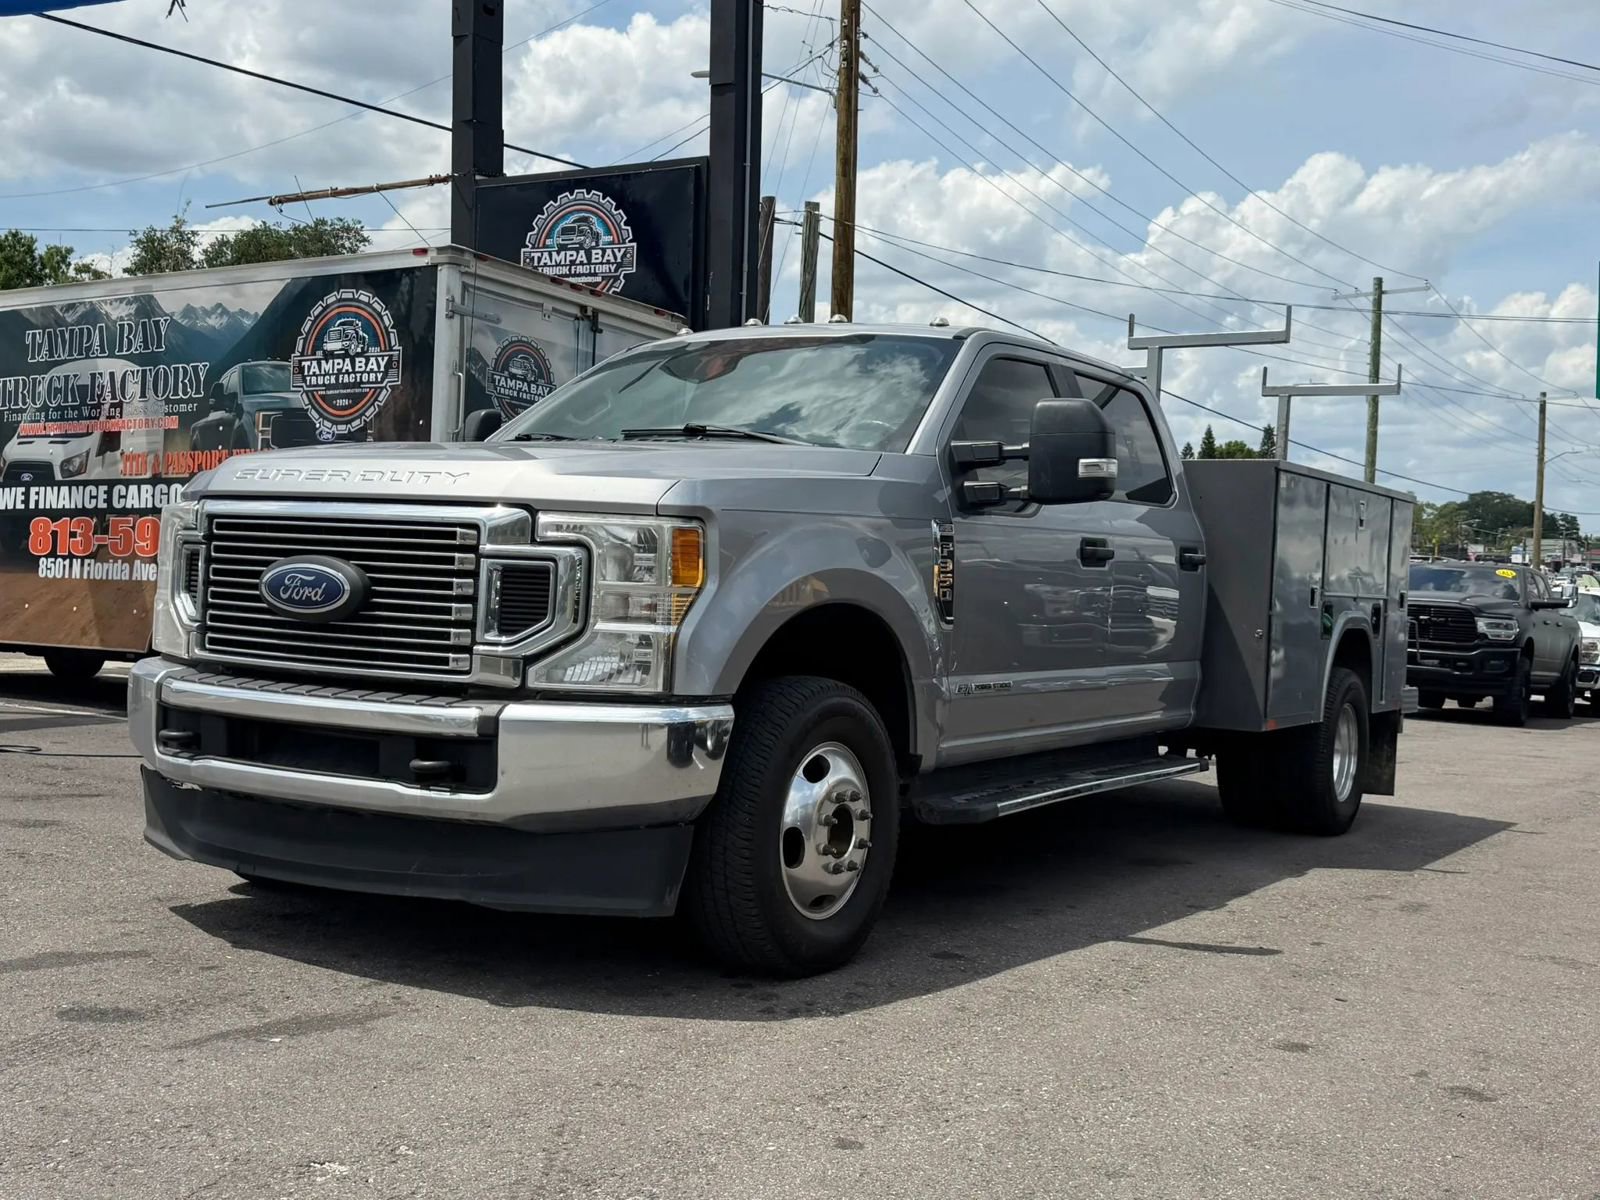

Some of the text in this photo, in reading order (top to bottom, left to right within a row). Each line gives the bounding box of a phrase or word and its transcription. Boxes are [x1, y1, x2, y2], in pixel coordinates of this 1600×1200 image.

[531, 248, 626, 266] TAMPA BAY
[538, 264, 617, 276] TRUCK FACTORY
[26, 317, 170, 362] TAMPA BAY
[302, 356, 389, 375] TAMPA BAY
[0, 362, 209, 409] TRUCK FACTORY
[306, 372, 383, 386] TRUCK FACTORY
[494, 375, 550, 396] TAMPA BAY
[497, 387, 518, 397] TRUCK
[4, 408, 45, 422] Financing
[49, 408, 63, 419] for
[64, 407, 78, 418] the
[151, 452, 161, 474] &
[164, 449, 228, 475] PASSPORT
[233, 468, 471, 484] SUPER DUTY
[0, 484, 182, 510] WE FINANCE CARGO
[29, 516, 161, 557] 813-59
[38, 557, 157, 581] 8501 N Florida Ave
[280, 573, 327, 601] Ford
